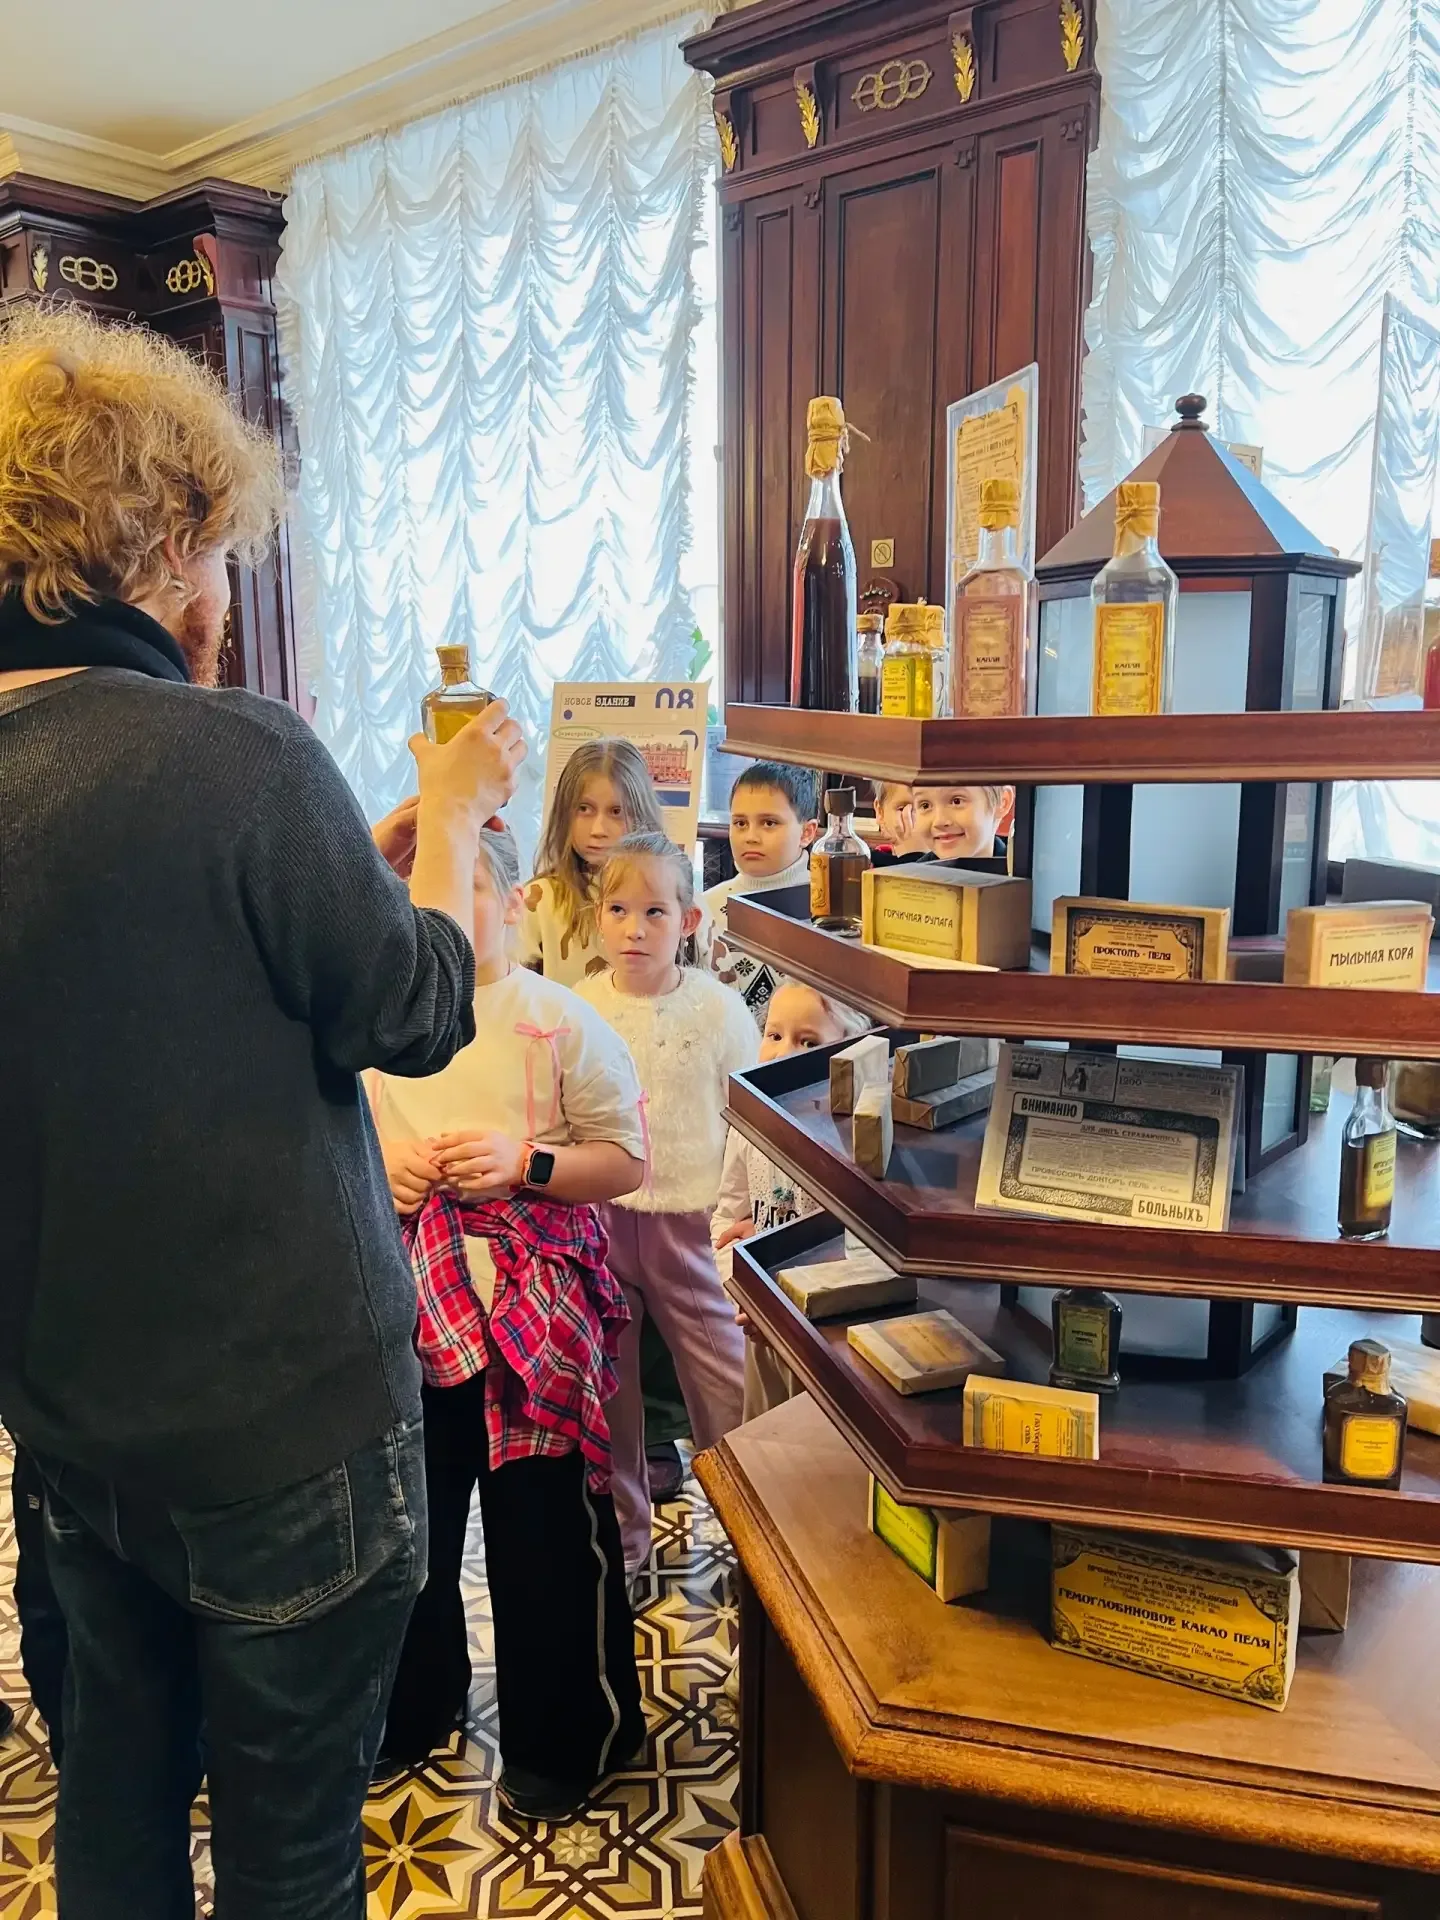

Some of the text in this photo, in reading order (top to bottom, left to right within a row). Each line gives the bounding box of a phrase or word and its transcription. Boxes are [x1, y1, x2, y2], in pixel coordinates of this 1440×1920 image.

[563, 697, 630, 707] НОВОЕ ЗДАНИЕ
[883, 908, 953, 929] ГОРЧИЧНАЯ БУМАГА
[1148, 950, 1171, 961] ПЕЛЯ
[1329, 946, 1414, 967] МЫЛЬНАЯ КОРА
[1137, 1199, 1204, 1223] БОЛЬНЫХЪ
[1058, 1586, 1177, 1627] ГЕМОГЛОБИНОВОЕ
[1181, 1619, 1228, 1639] КАКАО
[1233, 1632, 1271, 1649] ПЕЛЯ
